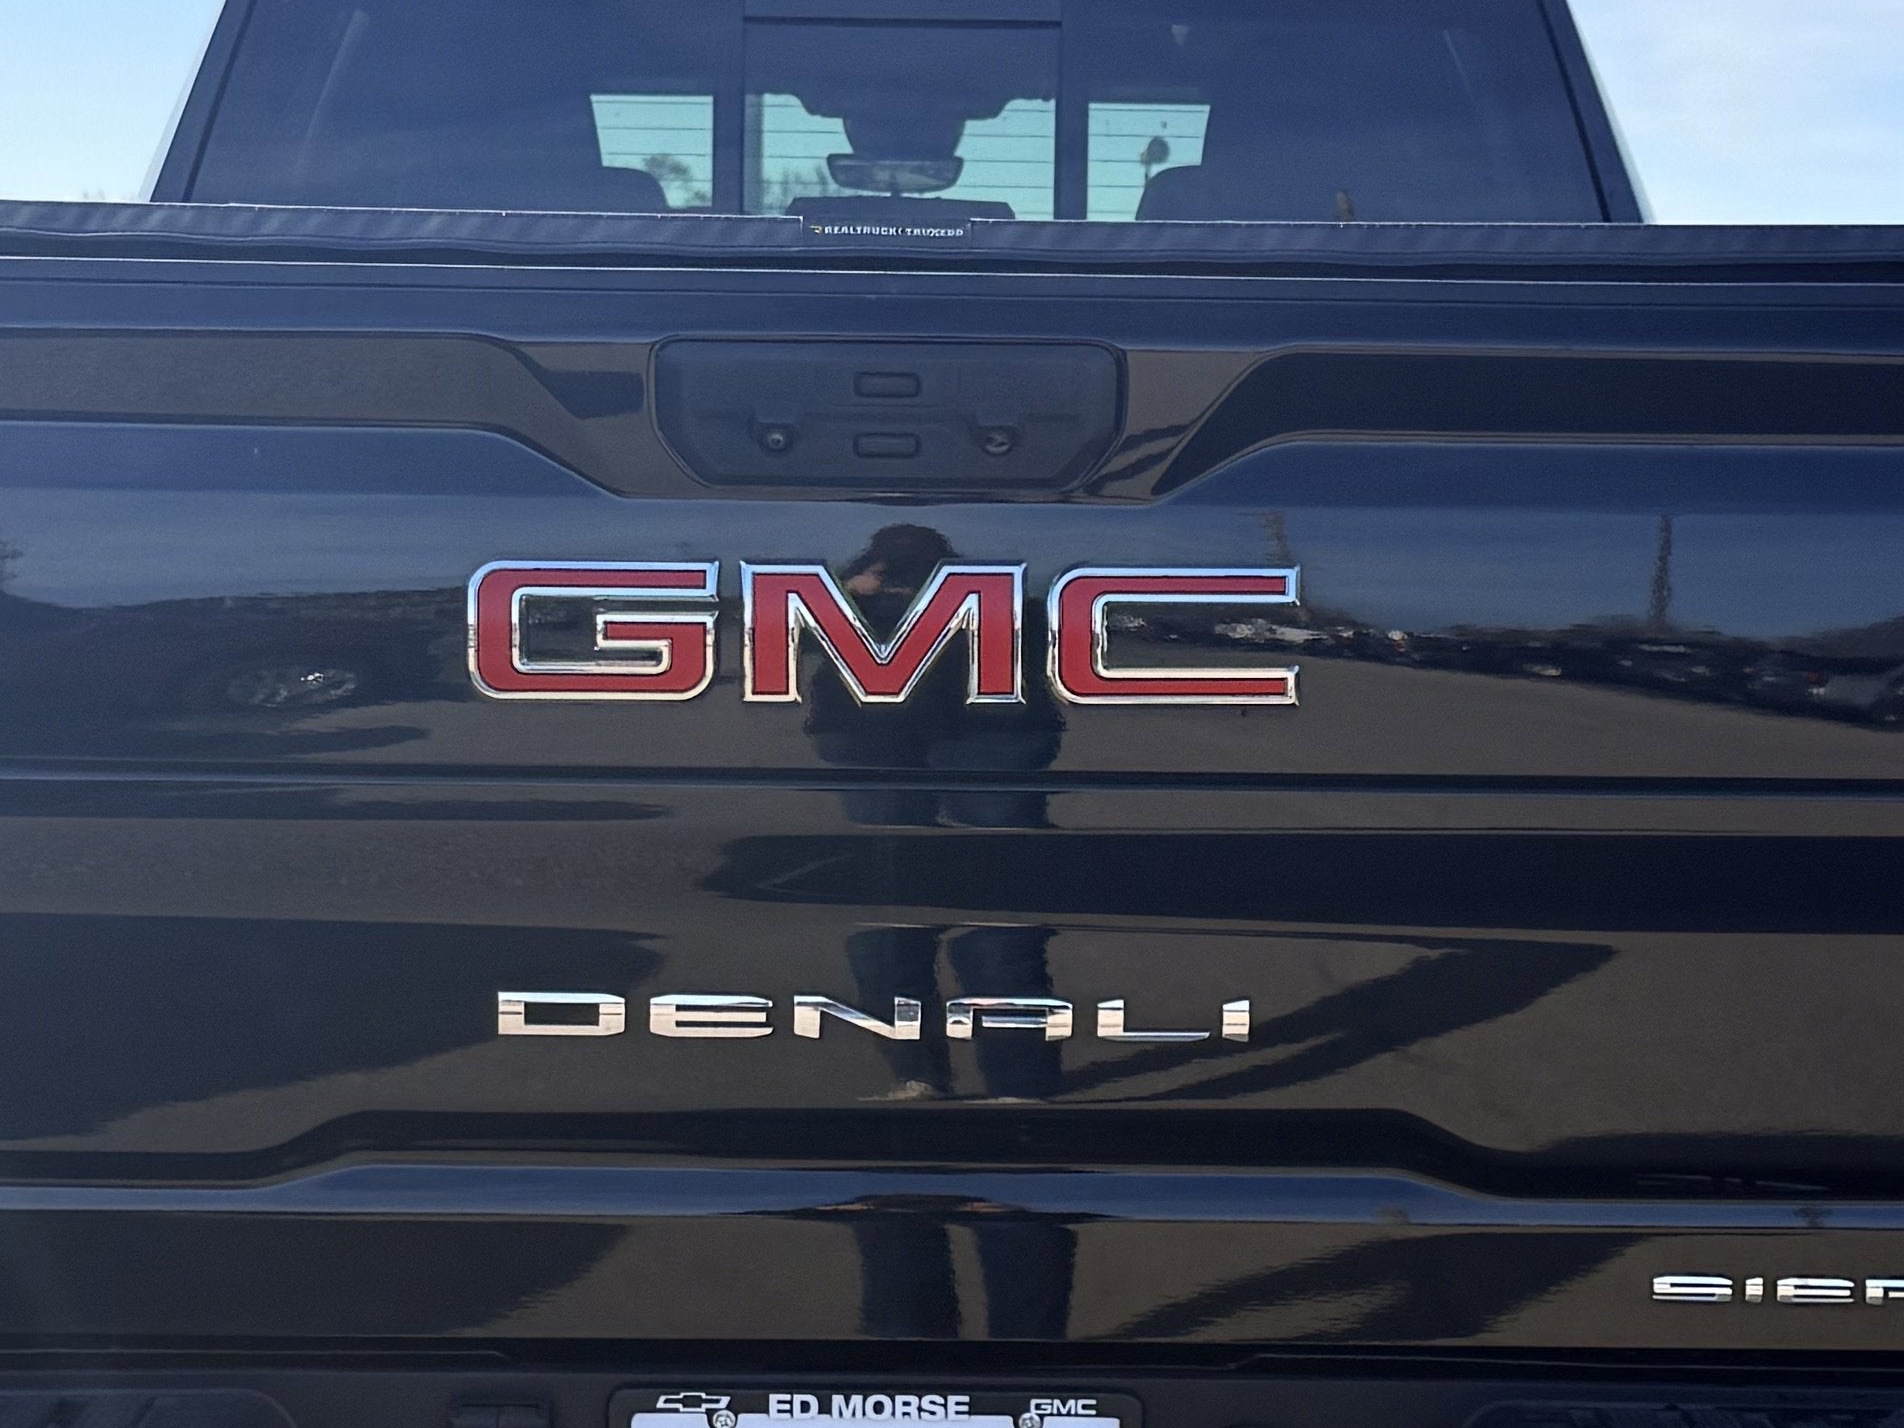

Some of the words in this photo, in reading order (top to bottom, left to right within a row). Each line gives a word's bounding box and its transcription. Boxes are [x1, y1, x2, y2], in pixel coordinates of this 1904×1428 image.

[467, 560, 1300, 706] GMC
[497, 991, 1250, 1042] DENALI
[768, 1393, 819, 1421] ED
[831, 1394, 971, 1421] MORSE
[1030, 1398, 1097, 1415] GMC
